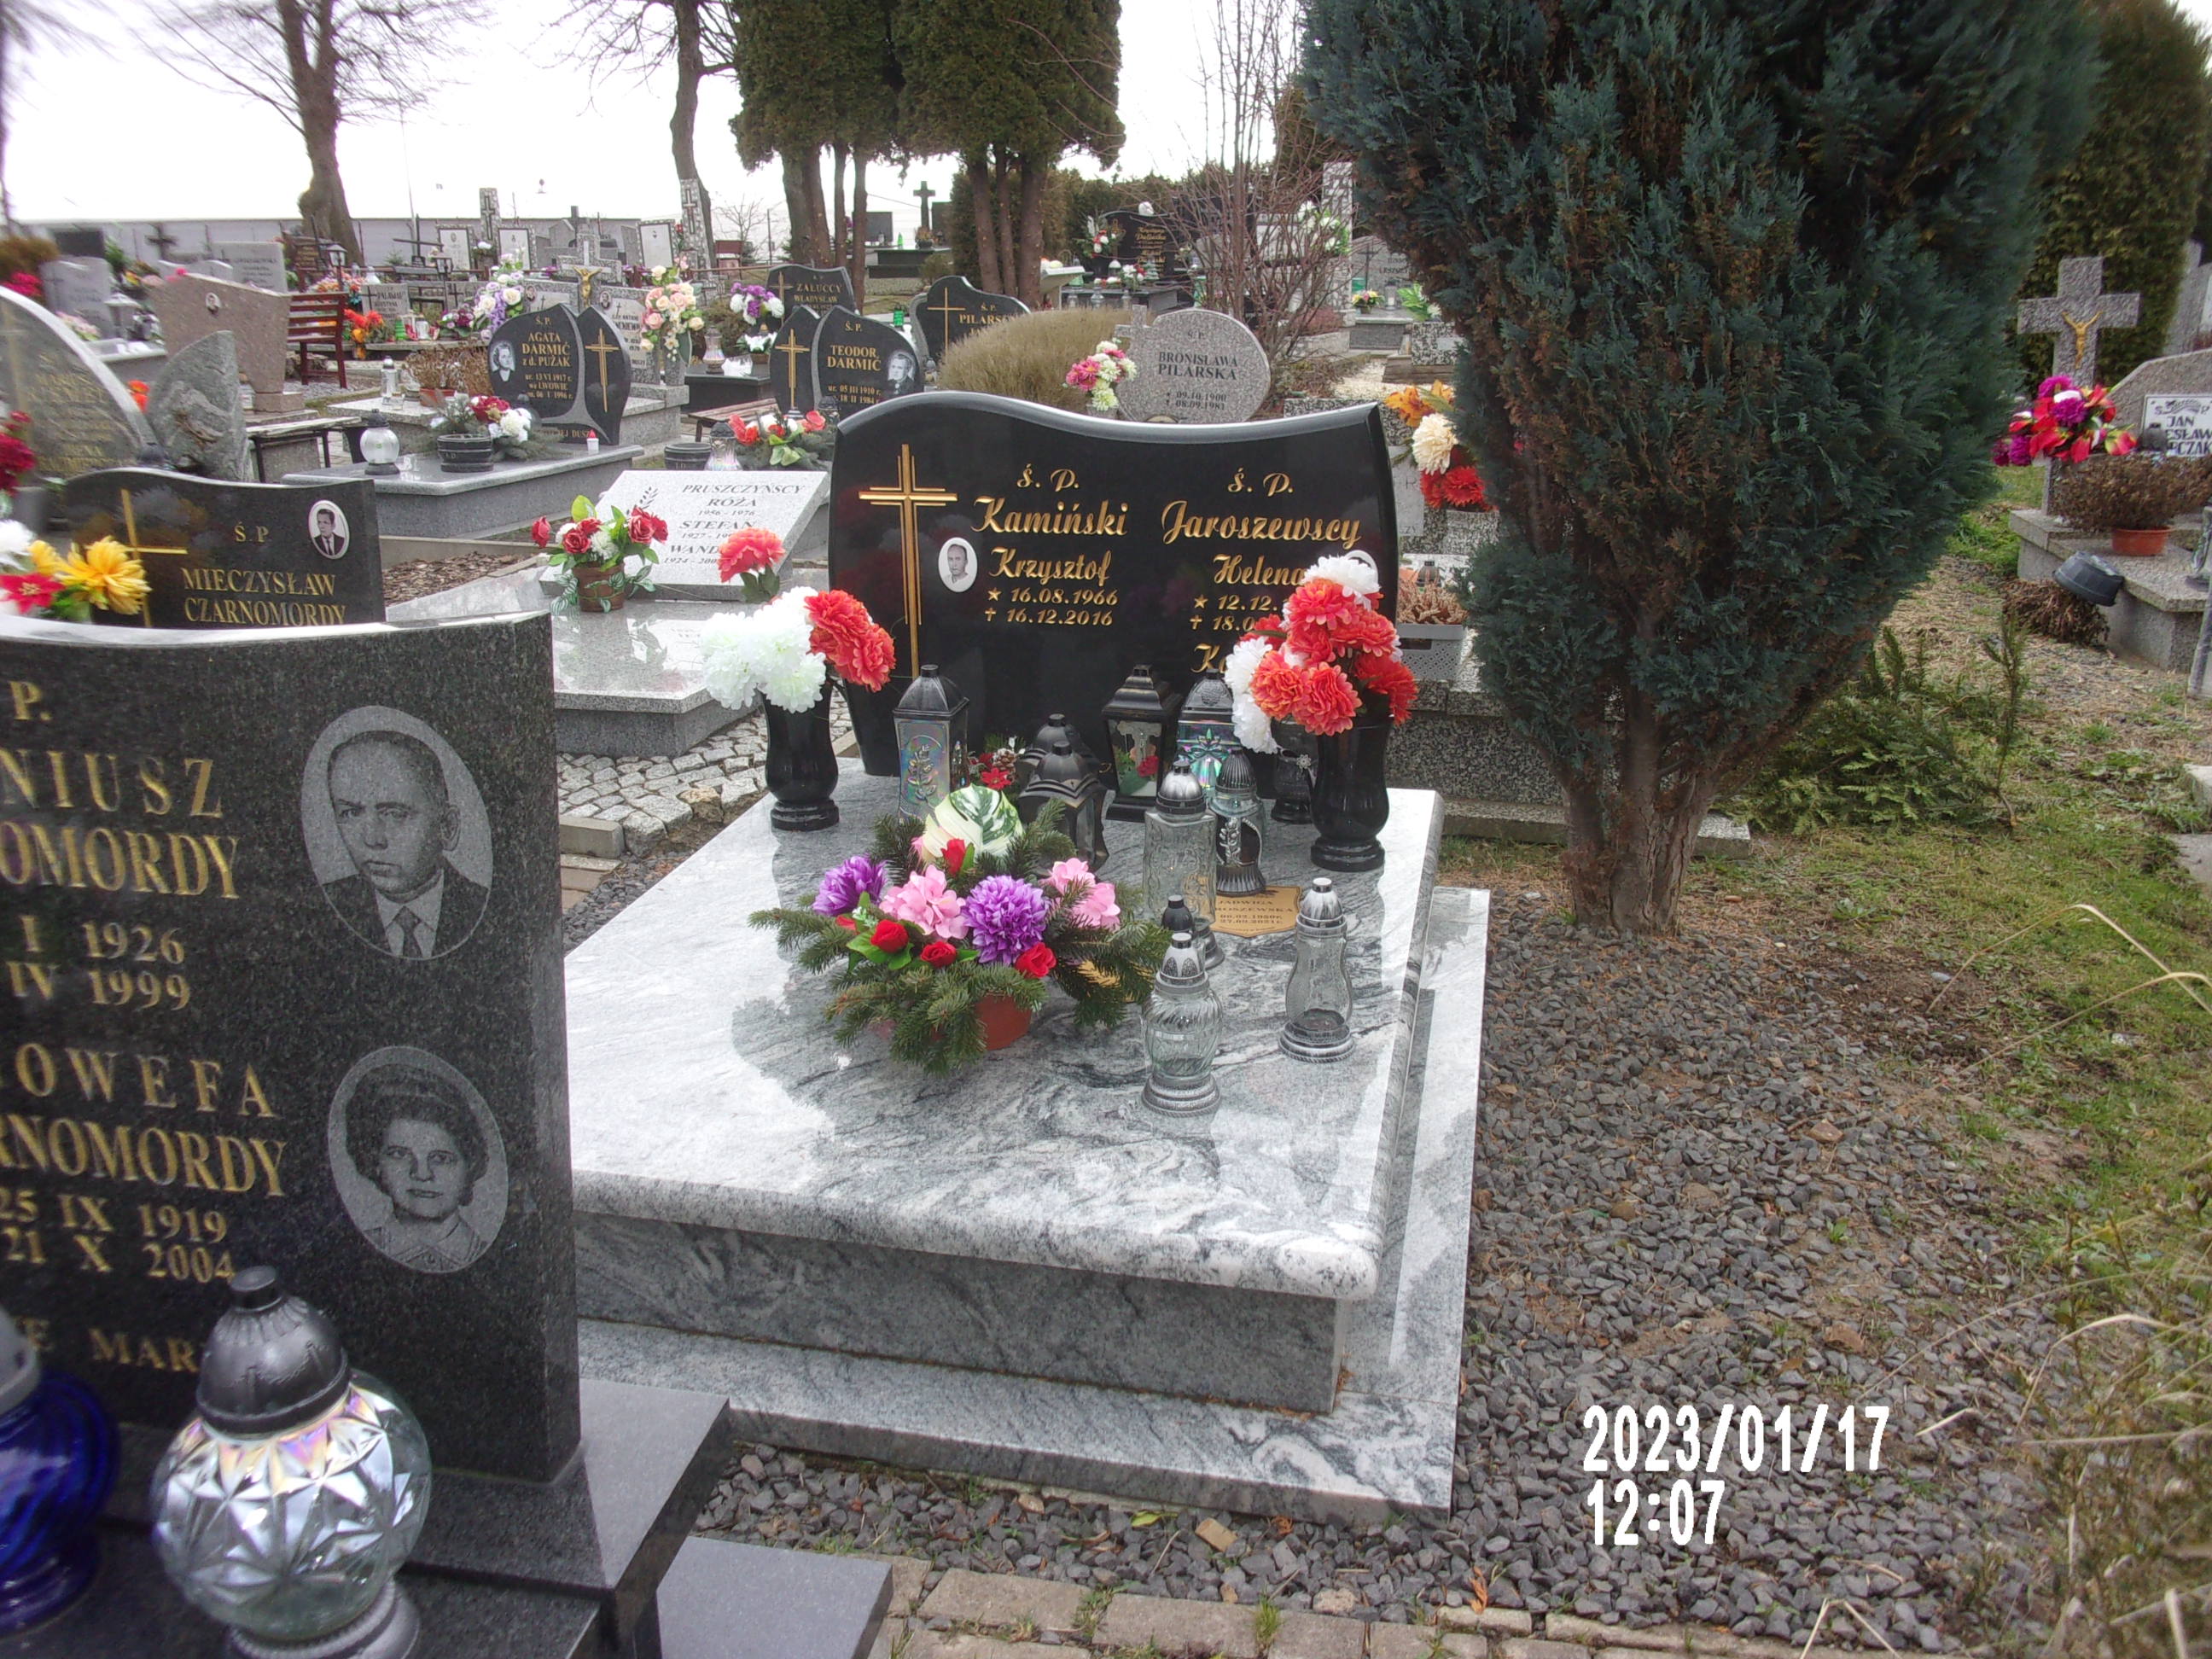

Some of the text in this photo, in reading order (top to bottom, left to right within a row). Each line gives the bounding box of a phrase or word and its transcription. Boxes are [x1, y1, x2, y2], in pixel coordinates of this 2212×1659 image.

[522, 341, 571, 356] DARMIĆ
[528, 332, 561, 342] AGATA
[827, 355, 882, 370] DARMIĆ
[830, 345, 877, 358] TEODOR
[1158, 364, 1237, 380] PILARSKA
[2167, 416, 2195, 427] JAN
[1016, 463, 1080, 492] Ś. P.
[1227, 467, 1295, 497] Ś. P.
[679, 520, 756, 530] STEFAN
[970, 496, 1128, 536] Kamiński
[1161, 500, 1362, 550] Jaroszewscy
[670, 544, 719, 554] WAND
[989, 546, 1112, 587] Krzysztof
[181, 568, 336, 597] MIECZYSŁAW
[1010, 587, 1119, 606] 16.08.1966
[184, 598, 346, 626] CZARNOMORDY
[1007, 608, 1113, 626] 16.12.2016
[1217, 595, 1287, 612] 12.12.
[10, 680, 53, 721] P.
[83, 923, 185, 964] 1926
[6, 961, 190, 1011] IV 1999
[56, 1195, 114, 1231] IX
[137, 1203, 228, 1244] 1919
[73, 1234, 114, 1272] X
[143, 1243, 236, 1283] 2004
[89, 1328, 201, 1373] MAR
